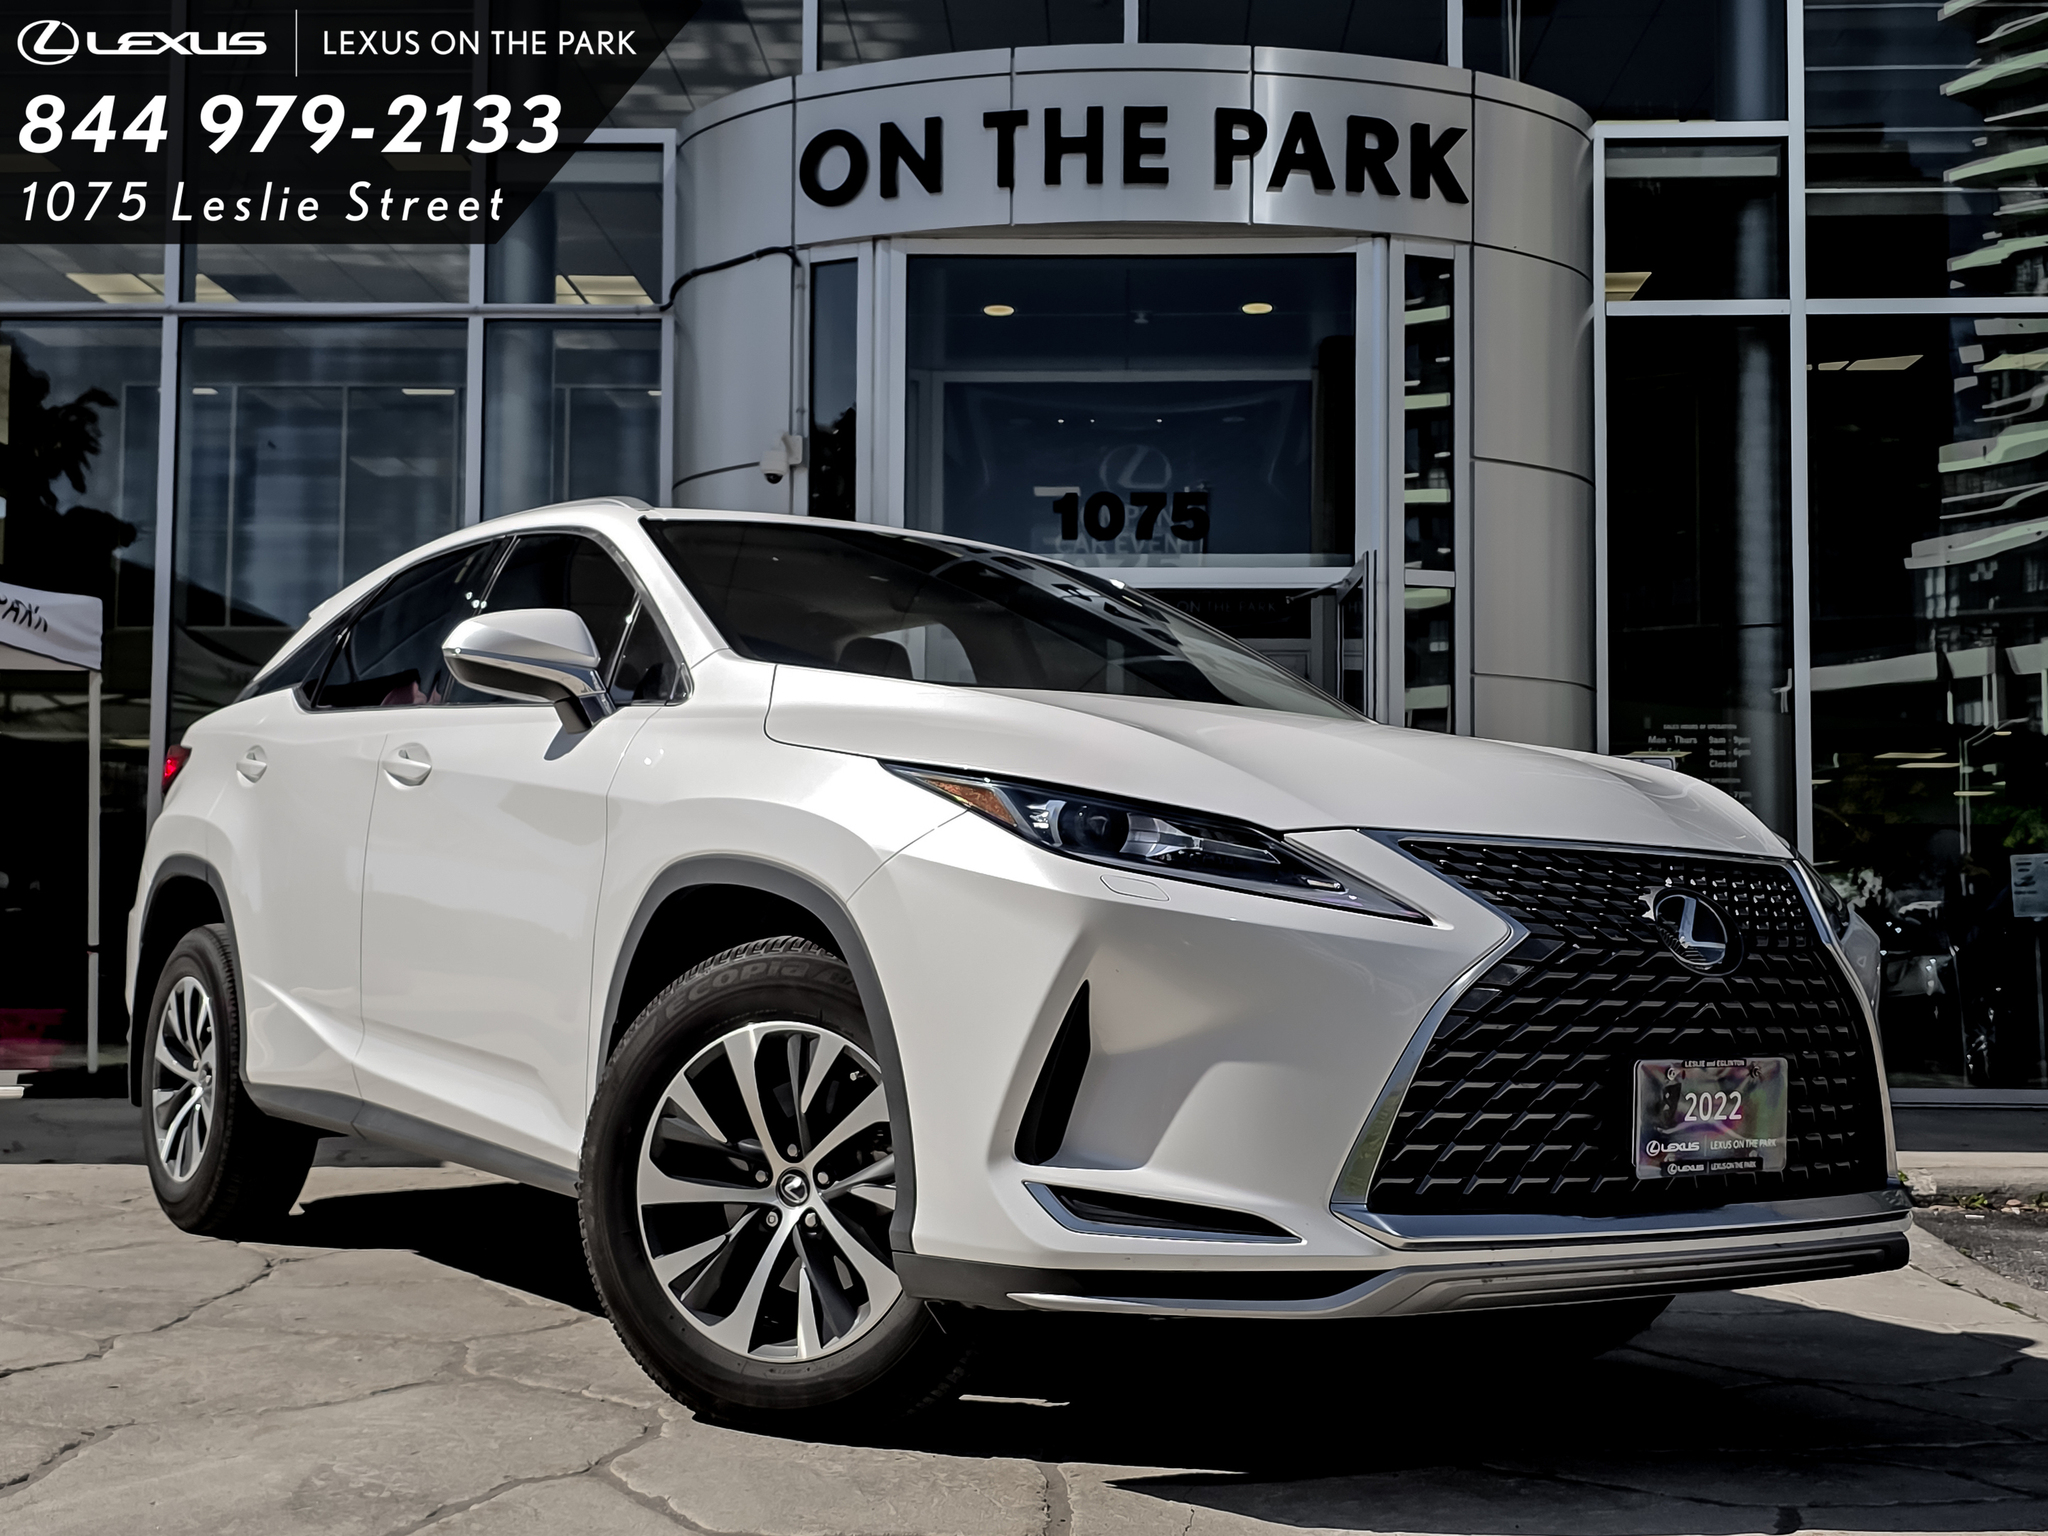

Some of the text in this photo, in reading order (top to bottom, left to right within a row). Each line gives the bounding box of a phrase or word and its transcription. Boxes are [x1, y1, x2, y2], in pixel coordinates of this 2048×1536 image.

[799, 105, 1469, 207] ON THE PARK
[1053, 491, 1210, 541] 1075
[1648, 735, 1667, 744] Mon
[1674, 735, 1698, 744] Thurs
[1709, 759, 1738, 768] Closed
[1684, 1060, 1705, 1068] LESLIE
[1684, 1091, 1742, 1122] 2022
[1661, 1141, 1700, 1153] LEXUS
[1710, 1138, 1777, 1150] LEXUS ON THE PARK
[1677, 1163, 1704, 1172] LEXUS
